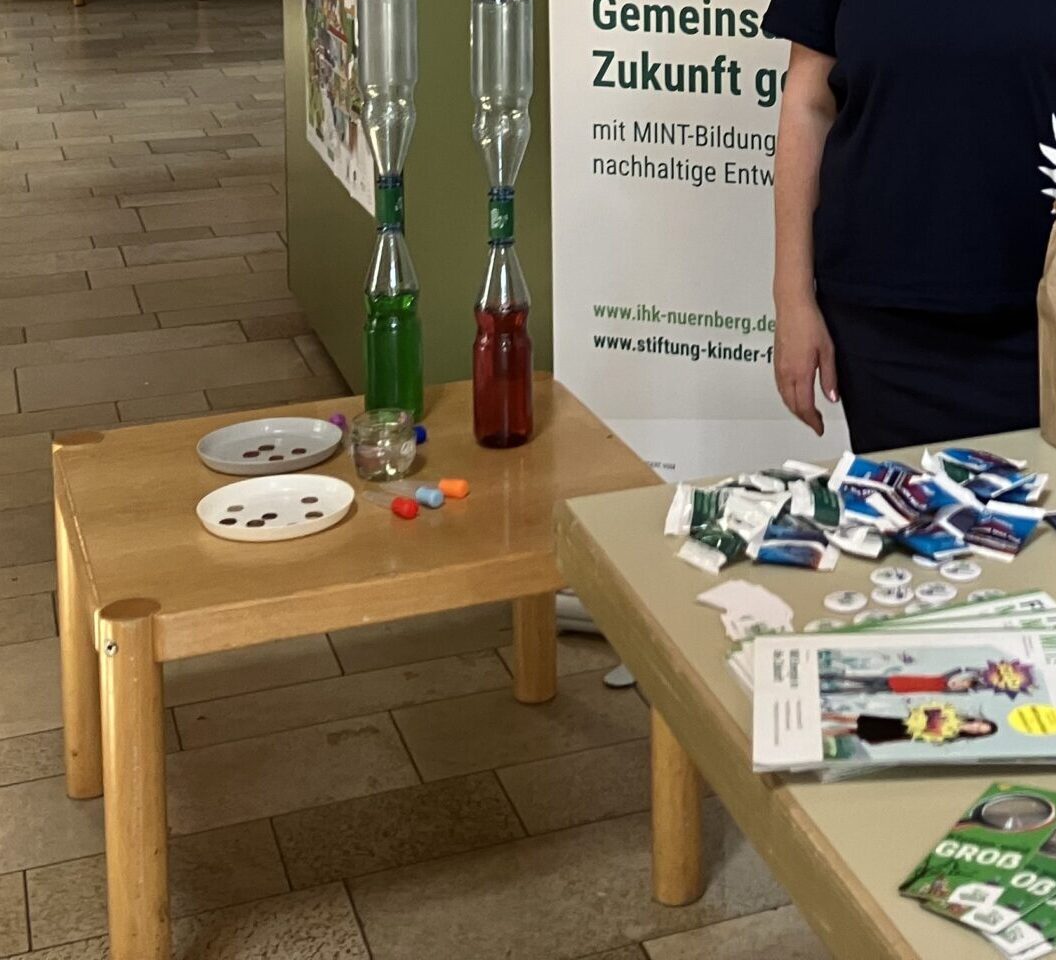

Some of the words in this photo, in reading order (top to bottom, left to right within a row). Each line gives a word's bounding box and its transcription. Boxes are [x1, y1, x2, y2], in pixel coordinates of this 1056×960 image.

[592, 49, 741, 96] Zukunft
[593, 119, 626, 141] mit
[633, 121, 776, 157] MINT-Bildung
[593, 155, 717, 187] nachhaltige
[593, 304, 776, 334] www.ihk-nuernberg.de
[593, 334, 774, 363] www.stiftung-kinder-f
